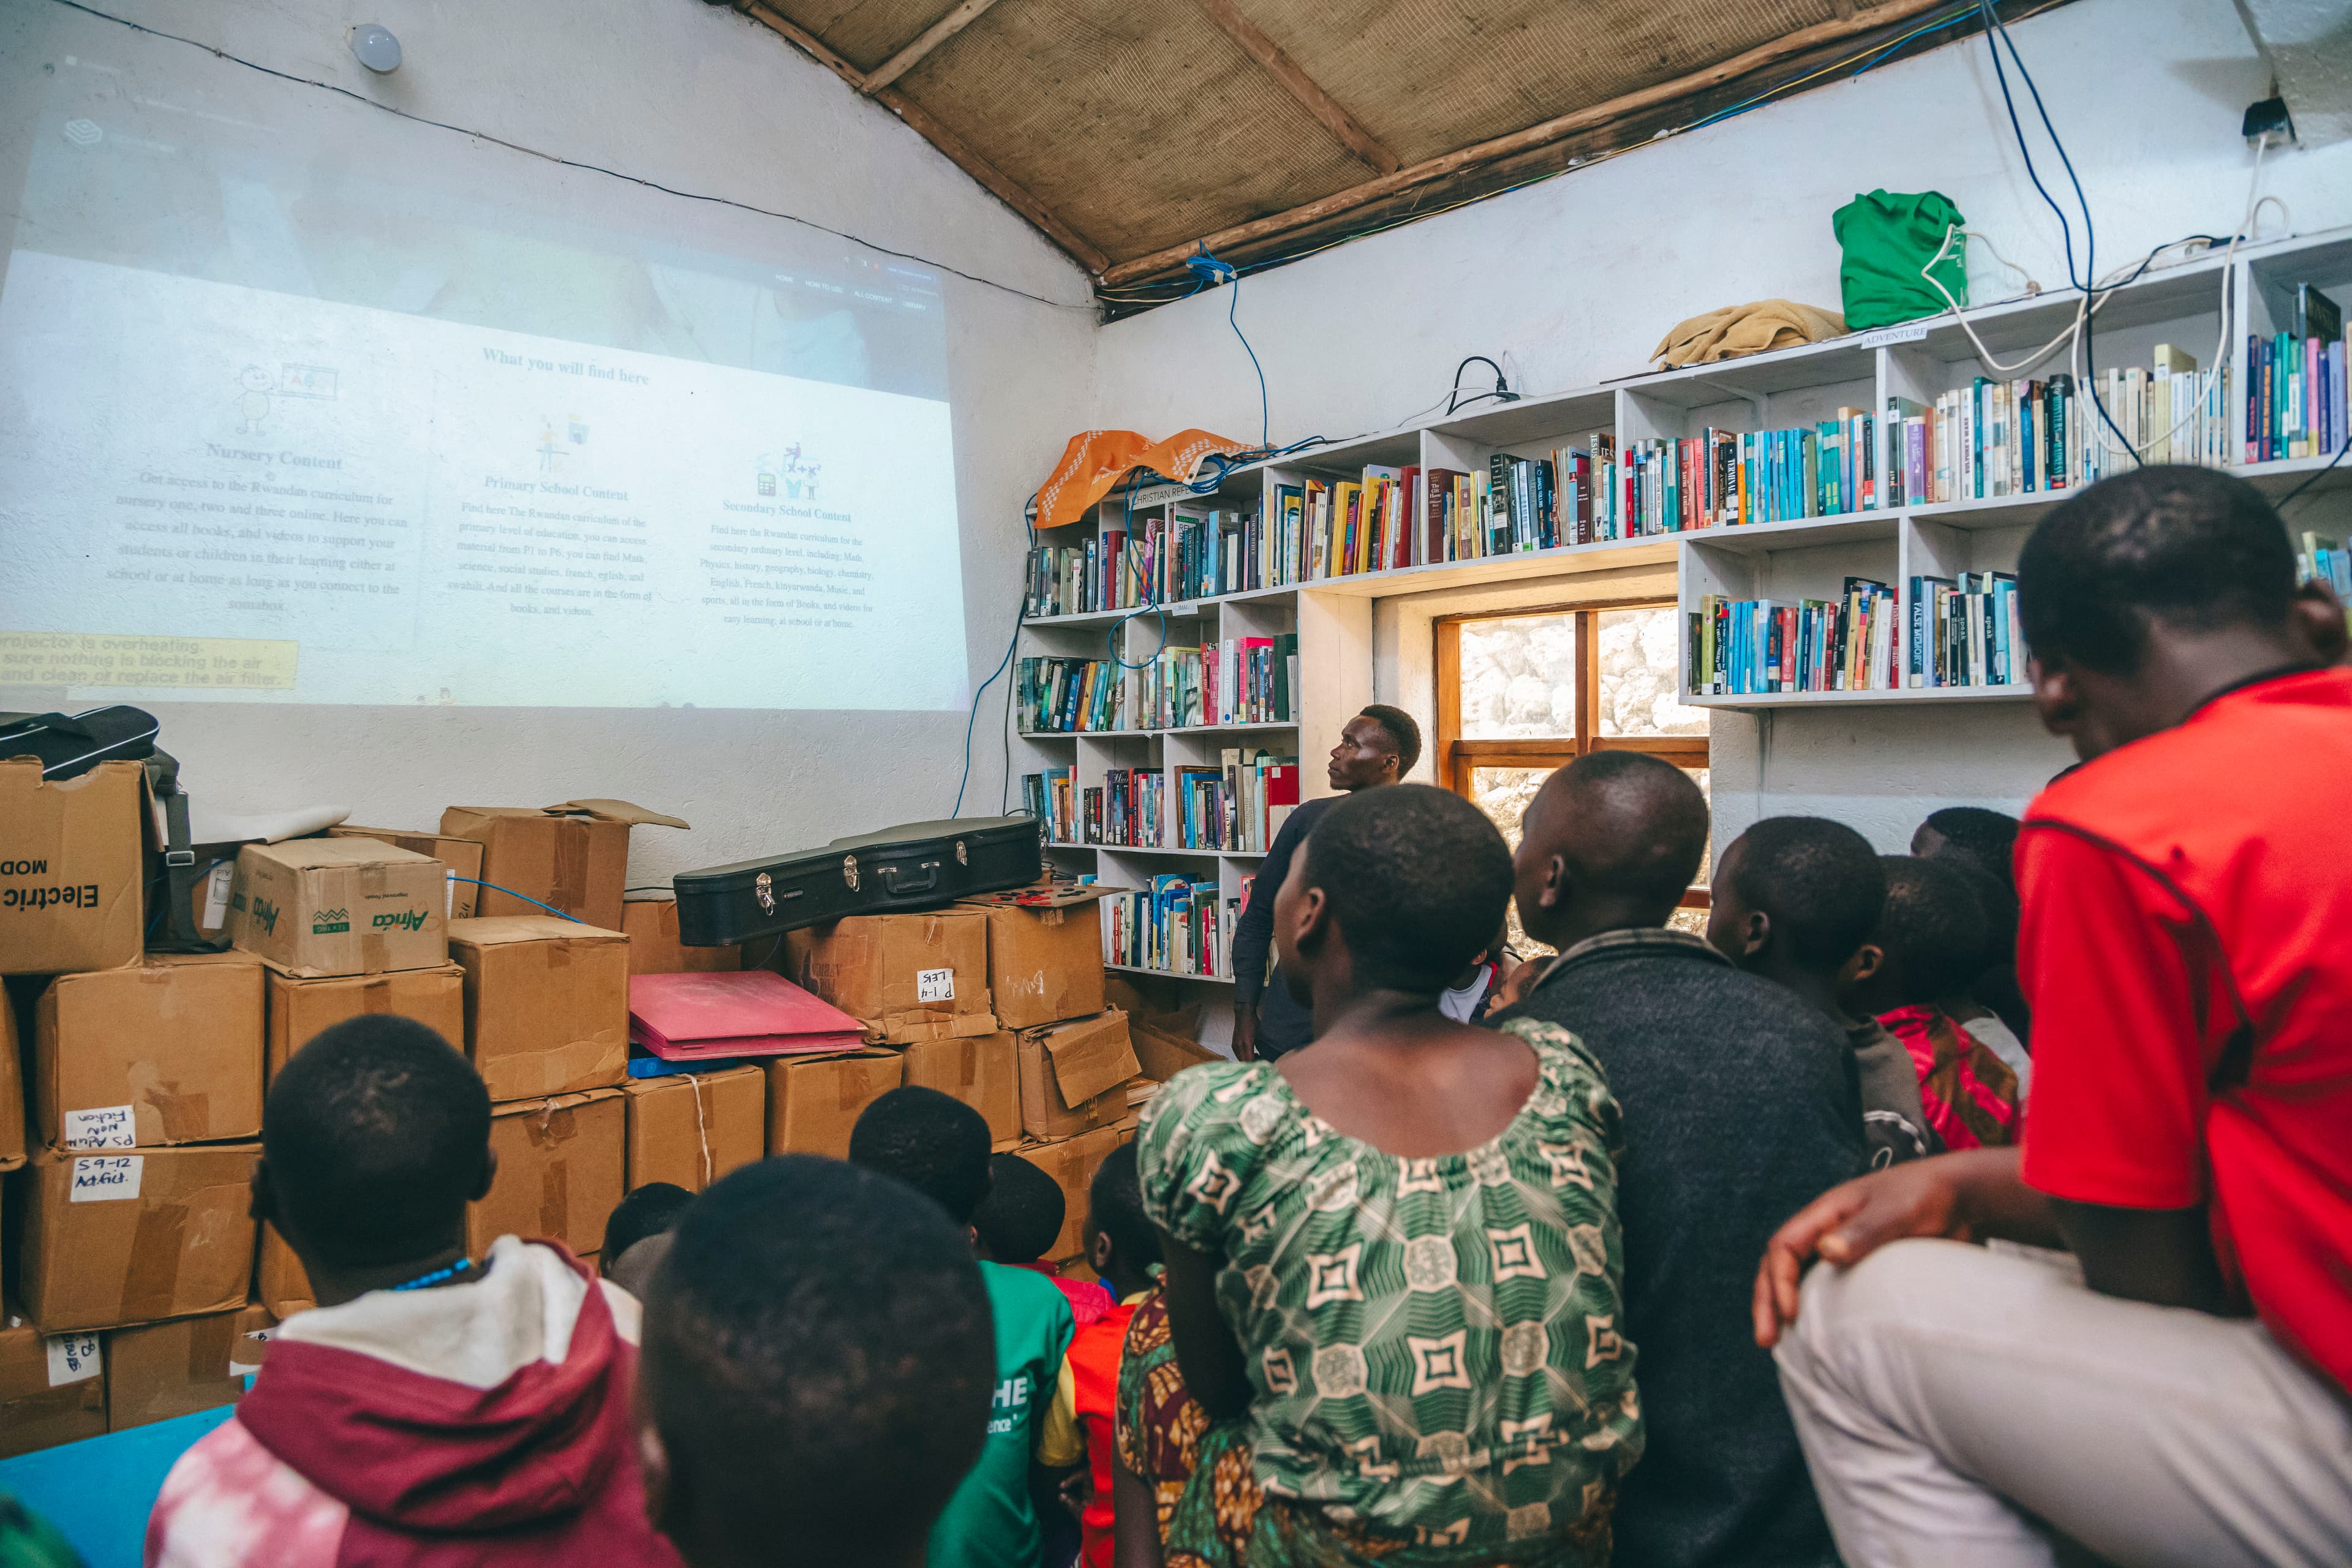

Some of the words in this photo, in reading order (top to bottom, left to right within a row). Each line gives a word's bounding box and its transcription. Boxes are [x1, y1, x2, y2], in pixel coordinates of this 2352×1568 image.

[775, 274, 794, 283] HOME
[865, 293, 892, 303] CONTENT
[902, 300, 926, 310] LIBRARY
[1864, 327, 1927, 345] ADVENTURE
[483, 347, 522, 366] What
[528, 358, 554, 372] you
[558, 361, 584, 375] will
[588, 364, 614, 380] find
[619, 369, 649, 385] here
[206, 443, 274, 466] Nursery
[279, 450, 342, 470] Content
[1727, 458, 1736, 496] TERMINAL
[140, 472, 163, 485] Get
[167, 478, 208, 489] access
[213, 479, 224, 490] to
[228, 479, 247, 491] the
[251, 481, 307, 498] Rwandan
[311, 488, 373, 504] curriculum
[377, 494, 393, 505] for
[484, 476, 535, 494] Primary
[540, 483, 579, 496] School
[582, 486, 628, 501] Content
[1133, 487, 1170, 505] CHRISTIAN
[116, 496, 164, 510] nursery
[201, 502, 225, 513] two
[230, 502, 251, 515] and
[255, 505, 285, 518] three
[289, 508, 330, 521] online.
[333, 511, 360, 524] Here
[363, 516, 385, 527] you
[388, 518, 408, 528] can
[461, 502, 483, 513] Find
[486, 505, 506, 515] here
[509, 507, 526, 517] The
[529, 509, 570, 521] Rwandan
[573, 512, 619, 526] curriculum
[622, 517, 631, 526] of
[633, 517, 646, 527] the
[723, 500, 775, 515] Secondary
[779, 505, 811, 518] School
[815, 509, 851, 522] Content
[126, 521, 168, 532] access
[172, 521, 188, 533] all
[238, 526, 260, 539] and
[266, 528, 304, 542] videos
[307, 532, 319, 543] to
[323, 533, 366, 548] support
[369, 537, 395, 549] your
[459, 521, 496, 535] primary
[499, 525, 521, 535] level
[524, 527, 533, 536] of
[584, 534, 600, 543] you
[620, 536, 647, 546] access
[710, 525, 729, 535] Find
[731, 526, 747, 536] here
[750, 528, 761, 537] the
[763, 529, 798, 540] Rwandan
[800, 533, 838, 544] curriculum
[840, 537, 850, 545] for
[852, 538, 862, 546] the
[118, 545, 173, 558] students
[176, 549, 190, 558] or
[195, 548, 246, 561] children
[251, 552, 262, 562] in
[267, 552, 295, 564] their
[298, 554, 346, 570] learning
[349, 556, 382, 570] either
[385, 560, 395, 571] at
[710, 543, 748, 555] secondary
[751, 546, 783, 558] ordinary
[853, 587, 865, 595] and
[0, 636, 75, 650] rojector
[81, 637, 96, 650] is
[102, 638, 204, 654] overheating.
[2, 654, 43, 664] sure
[48, 654, 115, 668] nothing
[120, 656, 134, 666] is
[139, 655, 206, 669] blocking
[212, 657, 236, 668] the
[243, 658, 262, 668] air
[1, 669, 34, 681] and
[40, 669, 88, 681] clean
[94, 671, 111, 681] or
[117, 671, 178, 685] replace
[184, 671, 209, 684] the
[215, 673, 234, 684] air
[241, 674, 281, 685] filter.
[1, 860, 47, 875] MOD
[3, 885, 99, 911] Electric
[372, 908, 429, 932] Africa
[944, 983, 953, 998] P
[78, 1110, 126, 1123] Fiction
